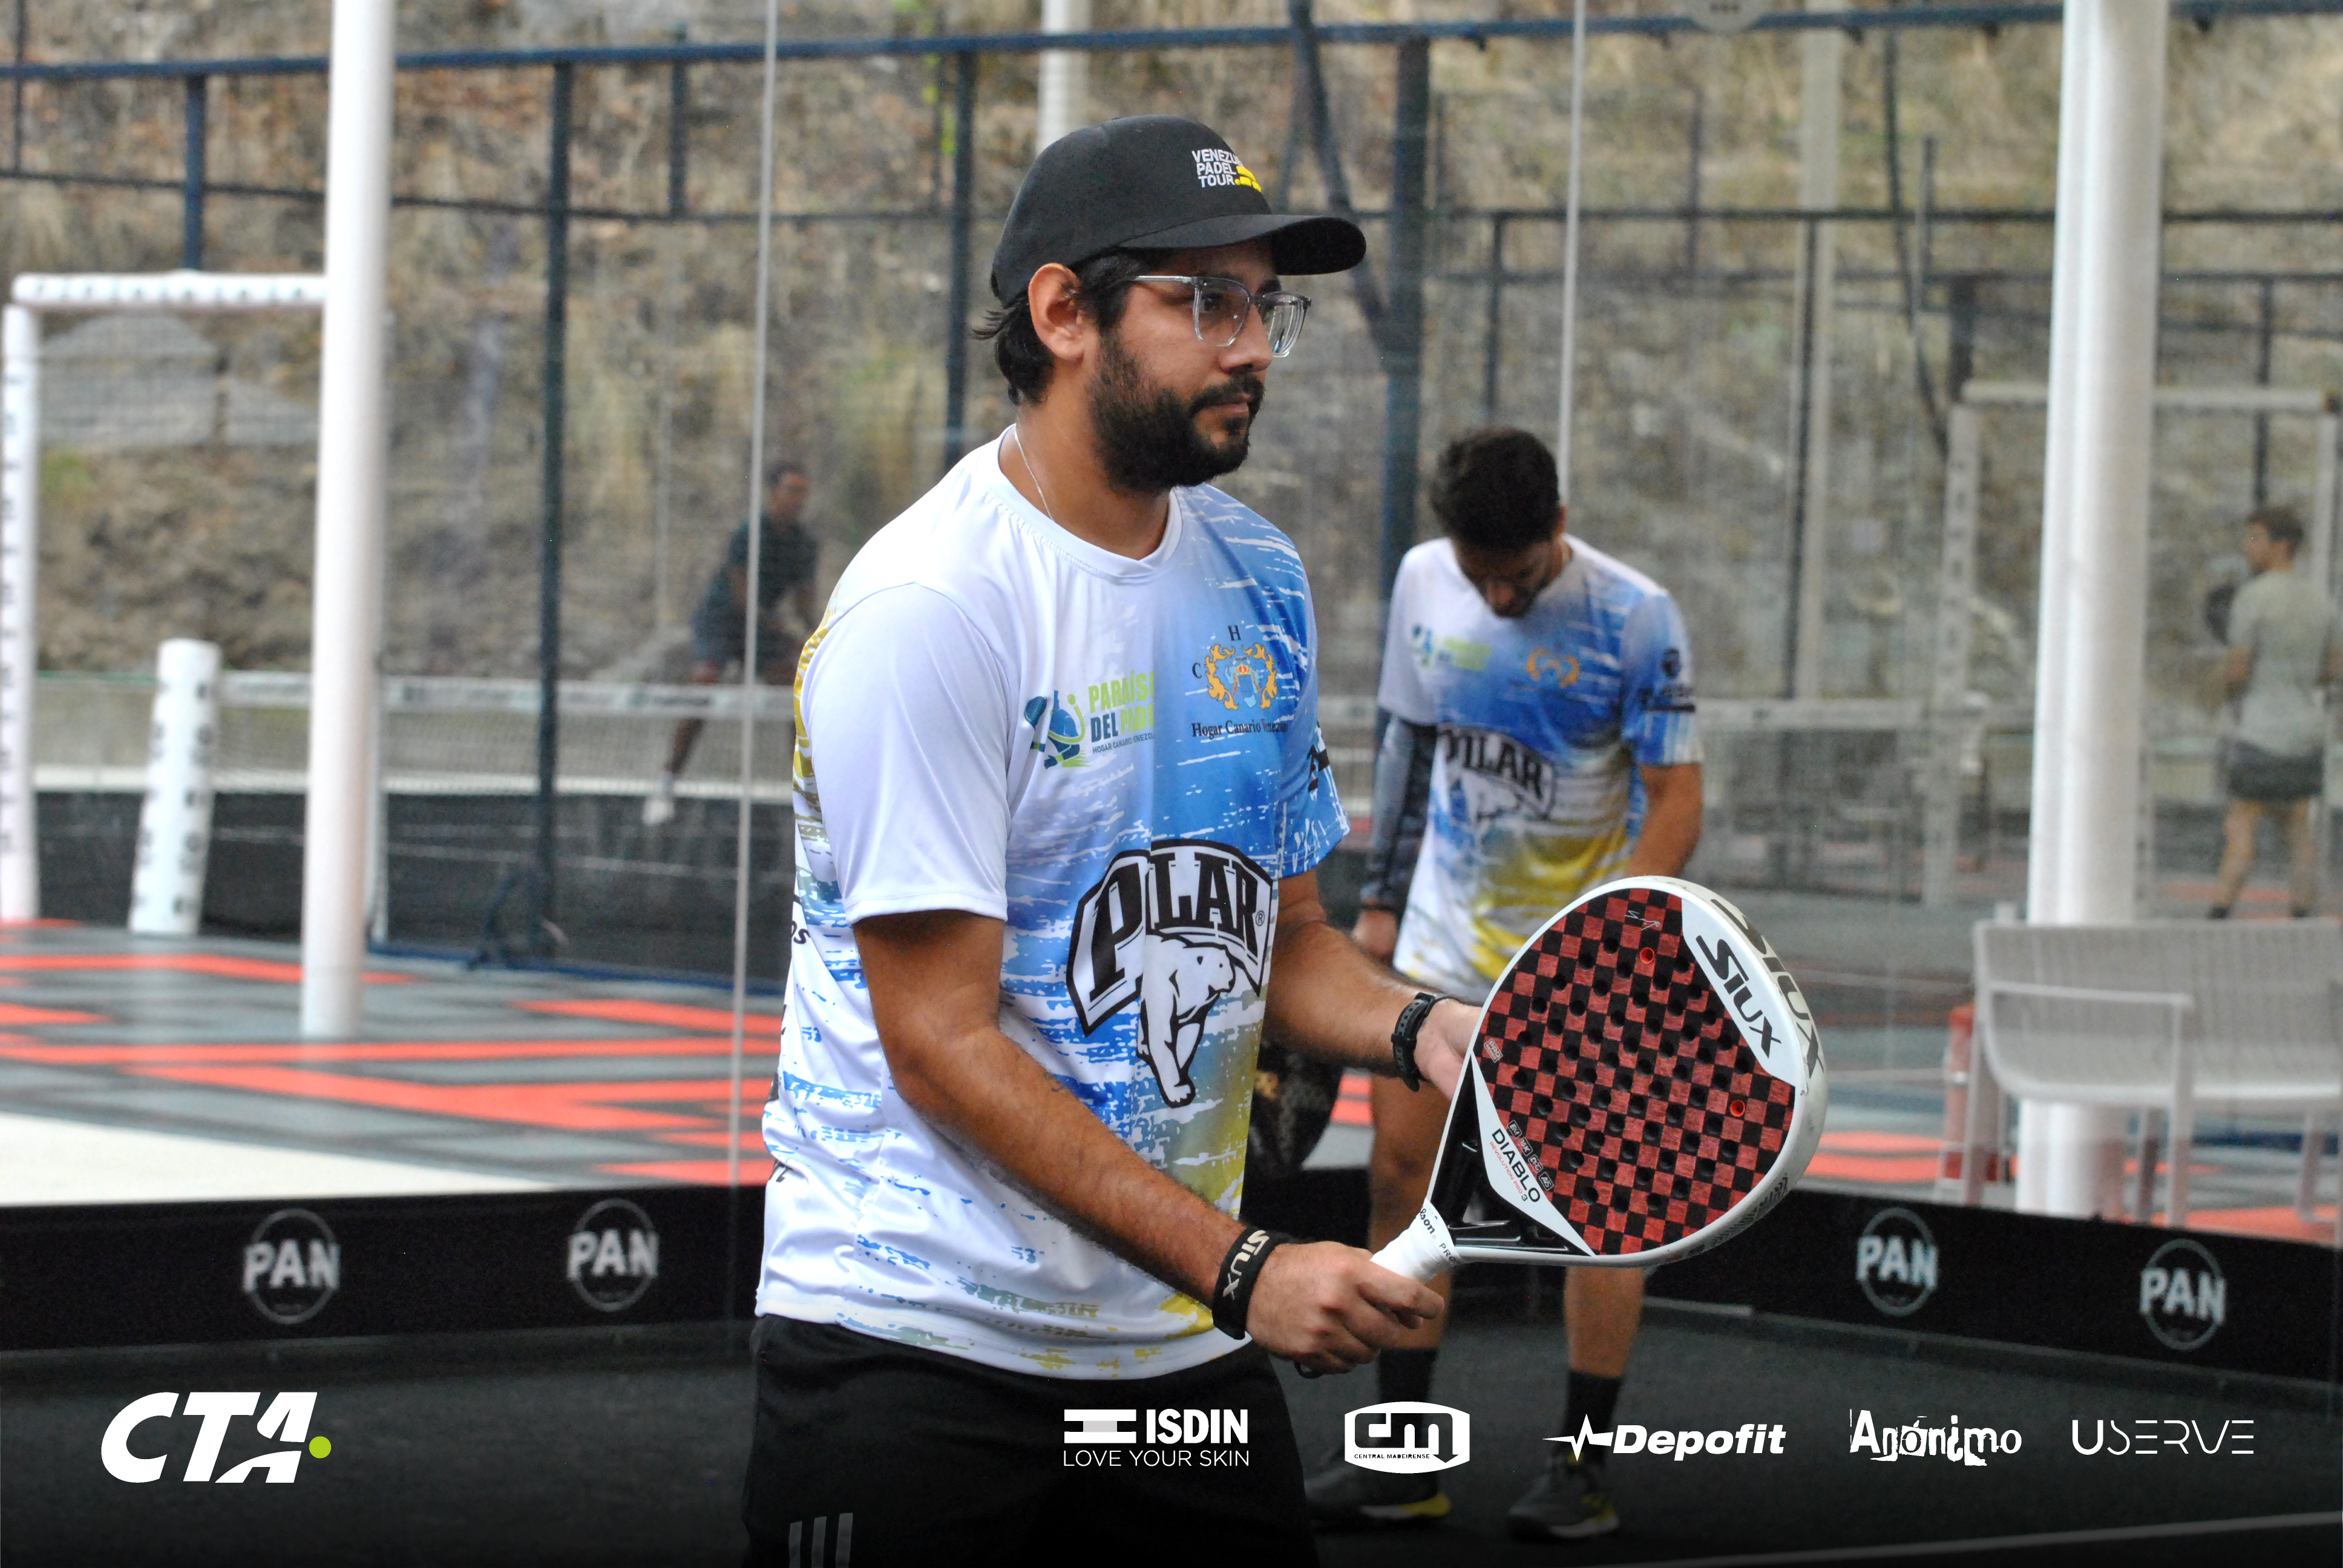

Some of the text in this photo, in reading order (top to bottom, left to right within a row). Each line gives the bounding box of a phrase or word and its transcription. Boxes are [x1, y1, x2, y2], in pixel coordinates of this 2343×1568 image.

[1196, 162, 1236, 176] PADEL
[1198, 174, 1236, 188] TOUR
[1228, 625, 1242, 641] H
[1192, 662, 1202, 679] C
[1090, 712, 1119, 743] DEL
[1191, 722, 1222, 740] Hogar
[1225, 720, 1261, 734] Canario
[1092, 743, 1113, 754] HOGAR
[1696, 935, 1782, 1059] SIUX
[1711, 899, 1824, 1079] SIUX
[1489, 1040, 1501, 1057] PRO
[1490, 1142, 1515, 1180] REVOLUTION
[1513, 1181, 1522, 1194] PRO
[1492, 1128, 1541, 1203] DIABLO
[1420, 1206, 1435, 1234] lson
[243, 1240, 340, 1292] PAN
[568, 1229, 659, 1280] PAN
[1222, 1230, 1270, 1300] SIUX
[1857, 1235, 1938, 1290] PAN
[2140, 1268, 2226, 1325] PAN
